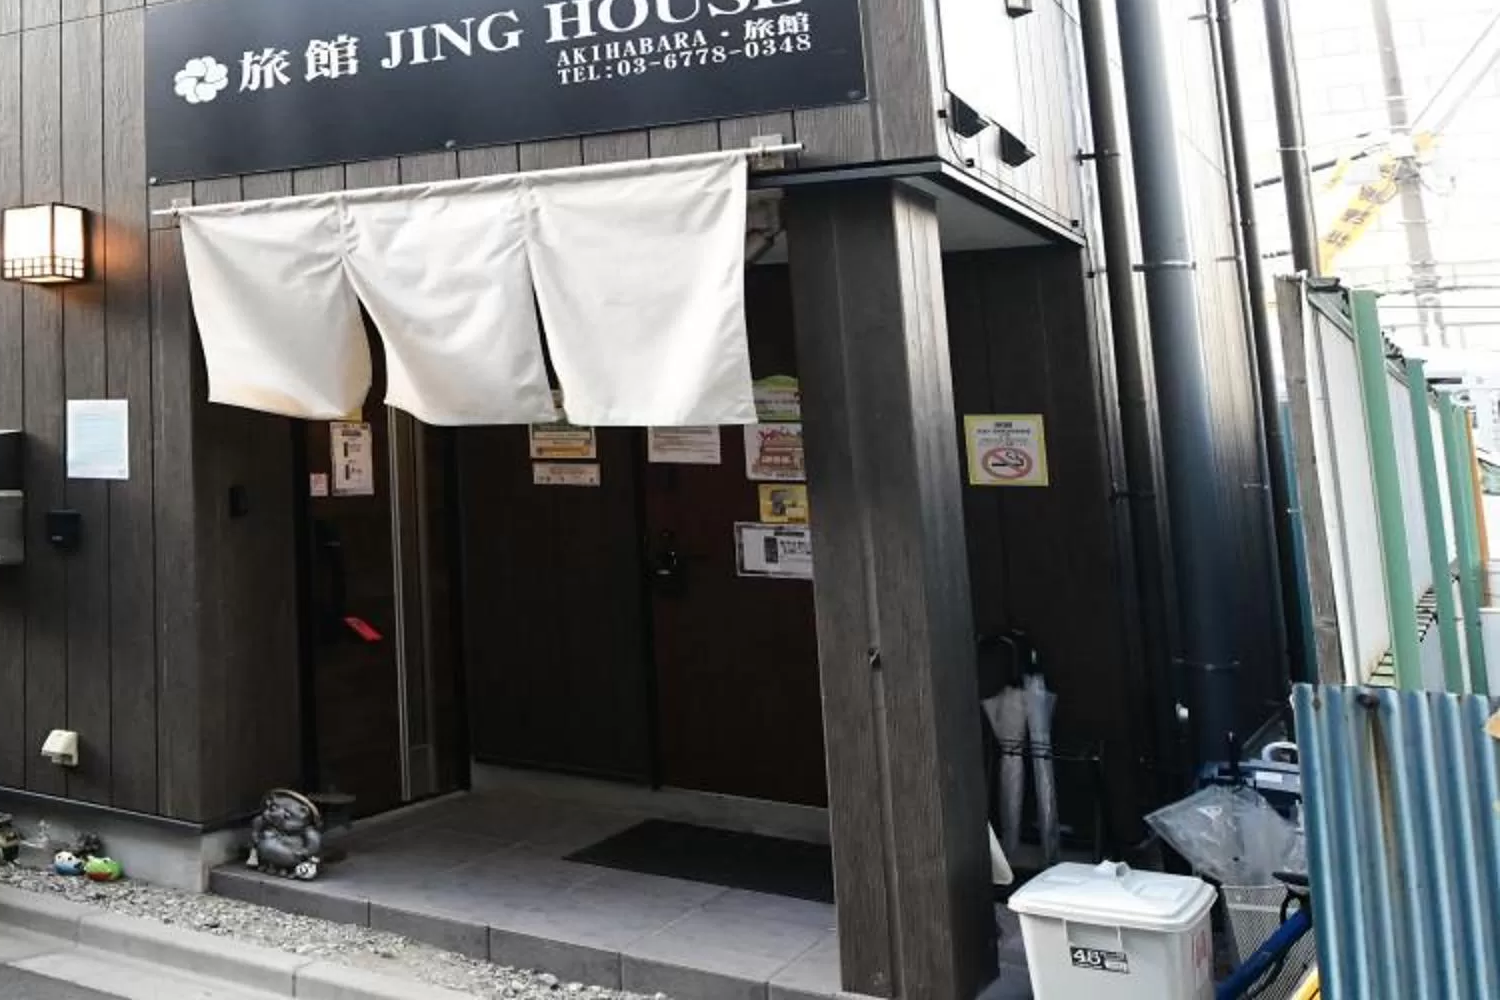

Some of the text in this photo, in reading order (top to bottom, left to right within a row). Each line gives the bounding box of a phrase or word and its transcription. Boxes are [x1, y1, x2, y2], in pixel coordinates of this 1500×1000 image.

[238, 34, 360, 93] 旅館
[380, 10, 524, 70] JING
[556, 29, 708, 68] AKIHABARA
